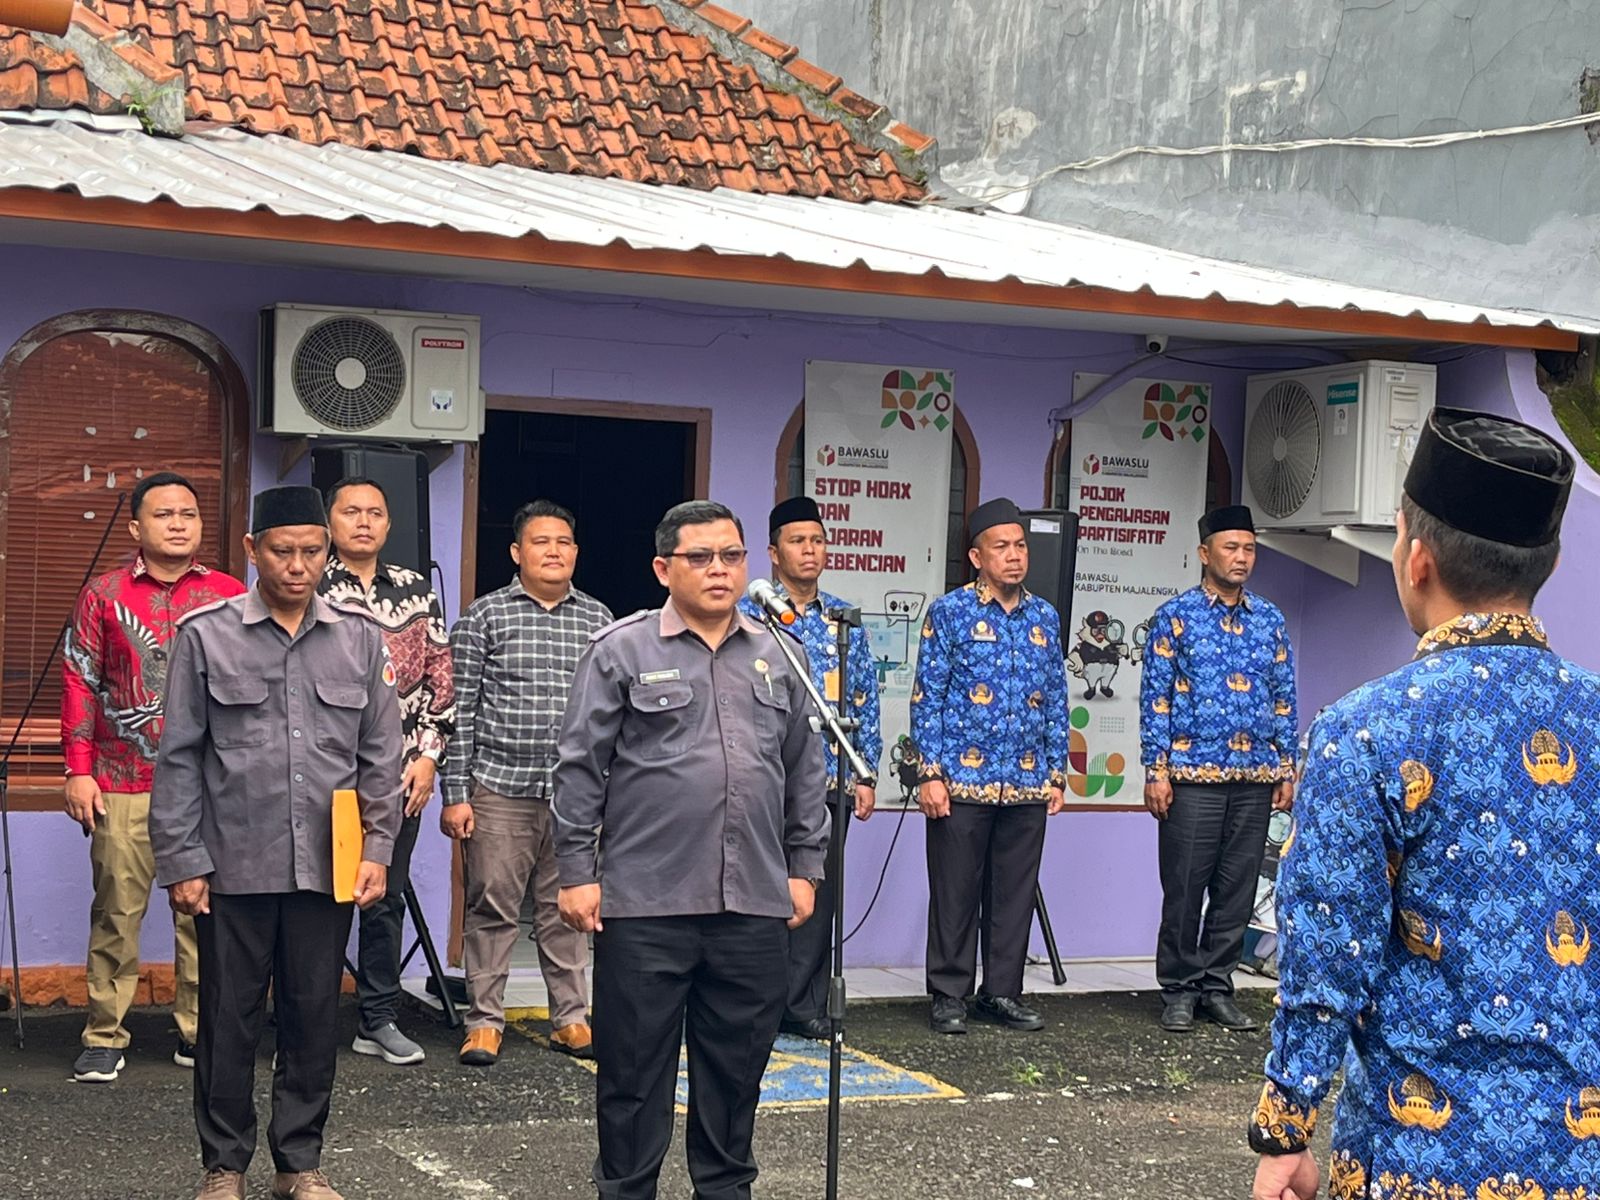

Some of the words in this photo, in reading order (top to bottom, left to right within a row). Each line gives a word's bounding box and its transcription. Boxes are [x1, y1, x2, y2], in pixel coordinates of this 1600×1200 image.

[838, 446, 889, 459] BAWASLU
[1102, 456, 1149, 468] BAWASLU
[815, 478, 861, 497] STOP
[866, 480, 911, 500] HOAX
[1080, 485, 1125, 502] POJOK
[1079, 505, 1170, 525] PENGAWASAN
[825, 528, 883, 547] JARAN
[1077, 526, 1166, 545] PARTISIFATIF
[825, 553, 906, 573] EBENCIAN
[1075, 572, 1118, 583] BAWASLU
[1074, 583, 1121, 594] KABUPTEN
[1122, 586, 1179, 596] MAJALENGKA
